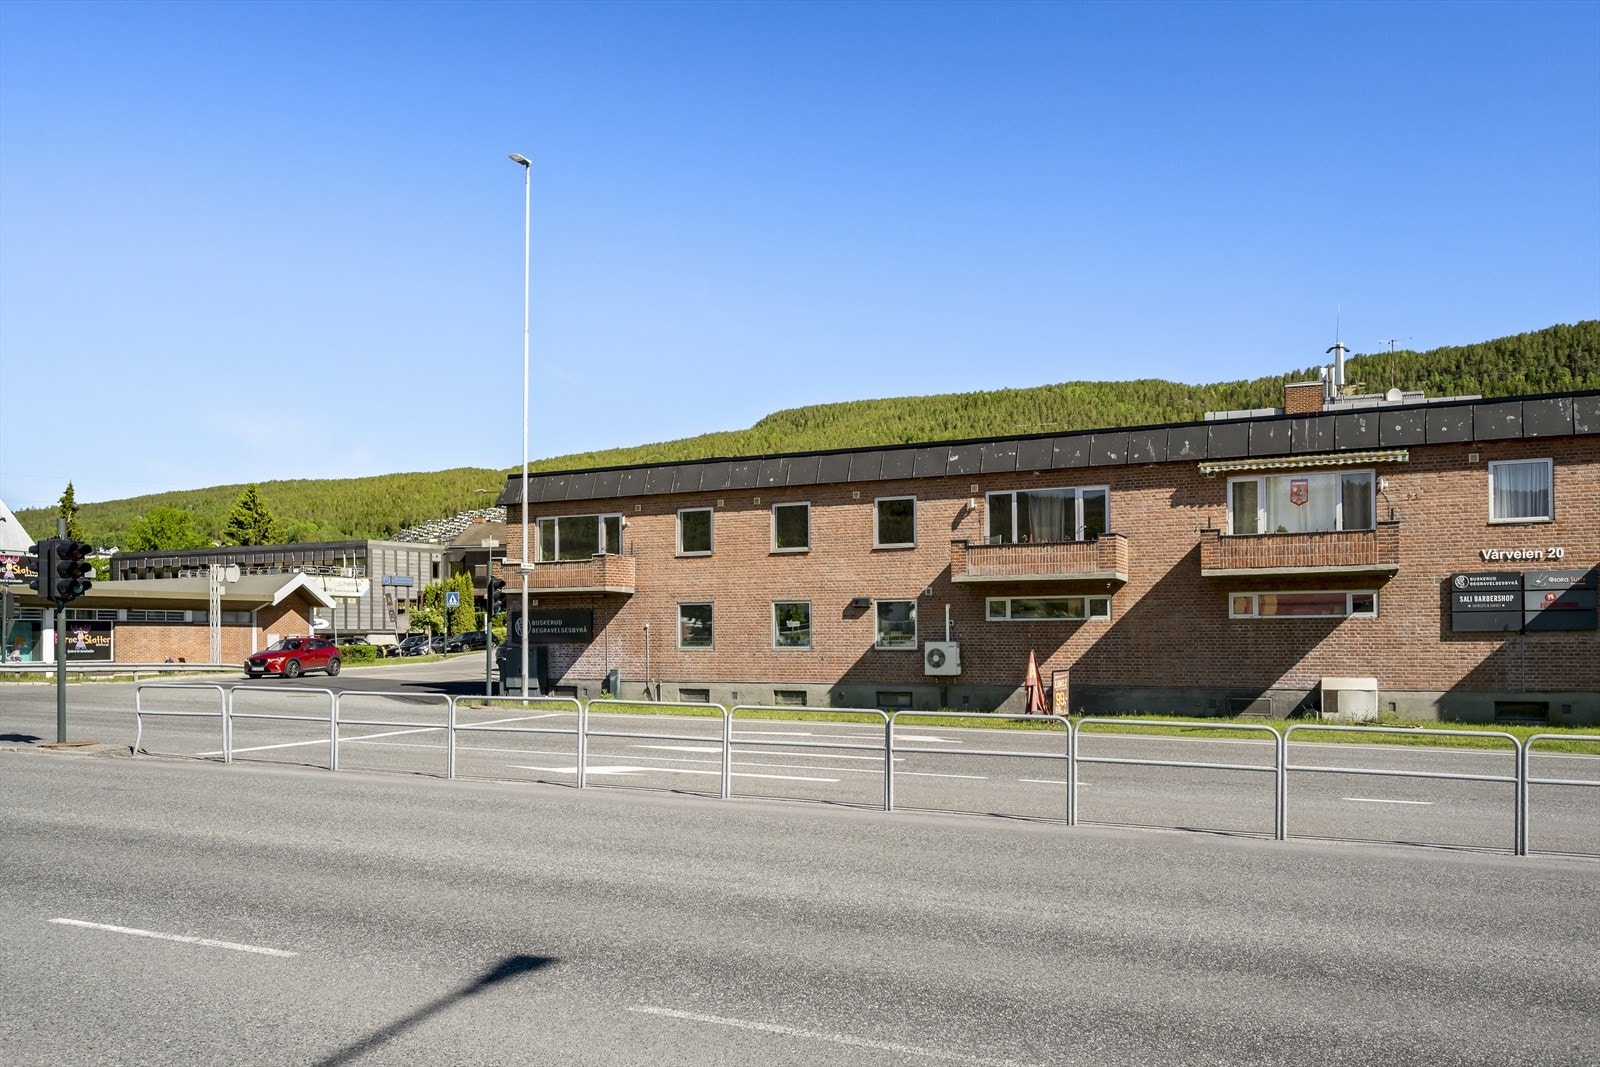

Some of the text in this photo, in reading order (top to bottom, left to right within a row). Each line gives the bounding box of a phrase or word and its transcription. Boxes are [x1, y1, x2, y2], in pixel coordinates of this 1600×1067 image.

[1547, 547, 1564, 558] 20
[1459, 594, 1514, 603] SALI BARBERSHOP
